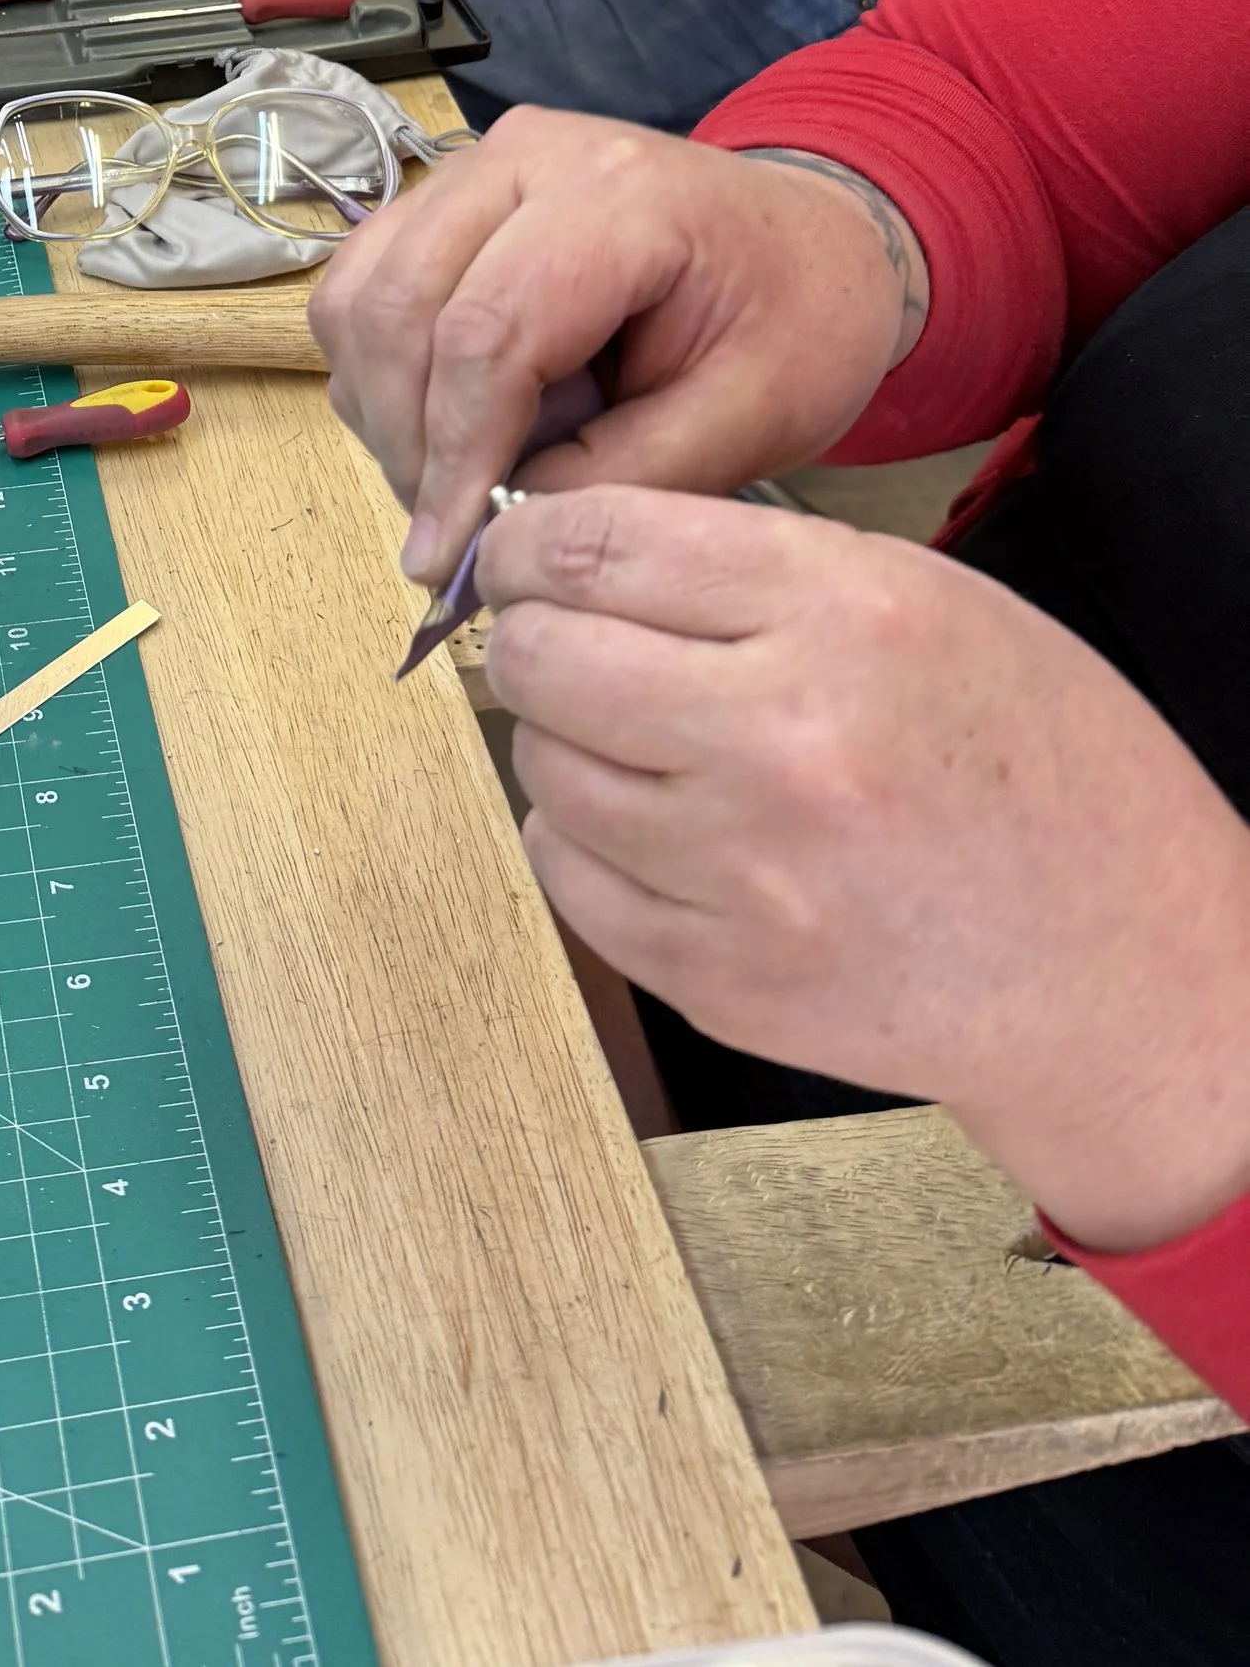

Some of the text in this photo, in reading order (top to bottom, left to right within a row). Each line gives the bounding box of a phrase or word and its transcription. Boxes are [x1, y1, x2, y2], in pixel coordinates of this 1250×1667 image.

[7, 627, 30, 651] 10
[35, 790, 58, 804] 8
[49, 880, 74, 894] 7
[66, 973, 91, 990] 6
[83, 1074, 110, 1090] 5
[101, 1178, 129, 1196] 4
[122, 1291, 152, 1312] 3
[144, 1417, 177, 1441] 2
[167, 1563, 201, 1584] 1
[28, 1588, 64, 1617] 2
[230, 1585, 262, 1640] inch
